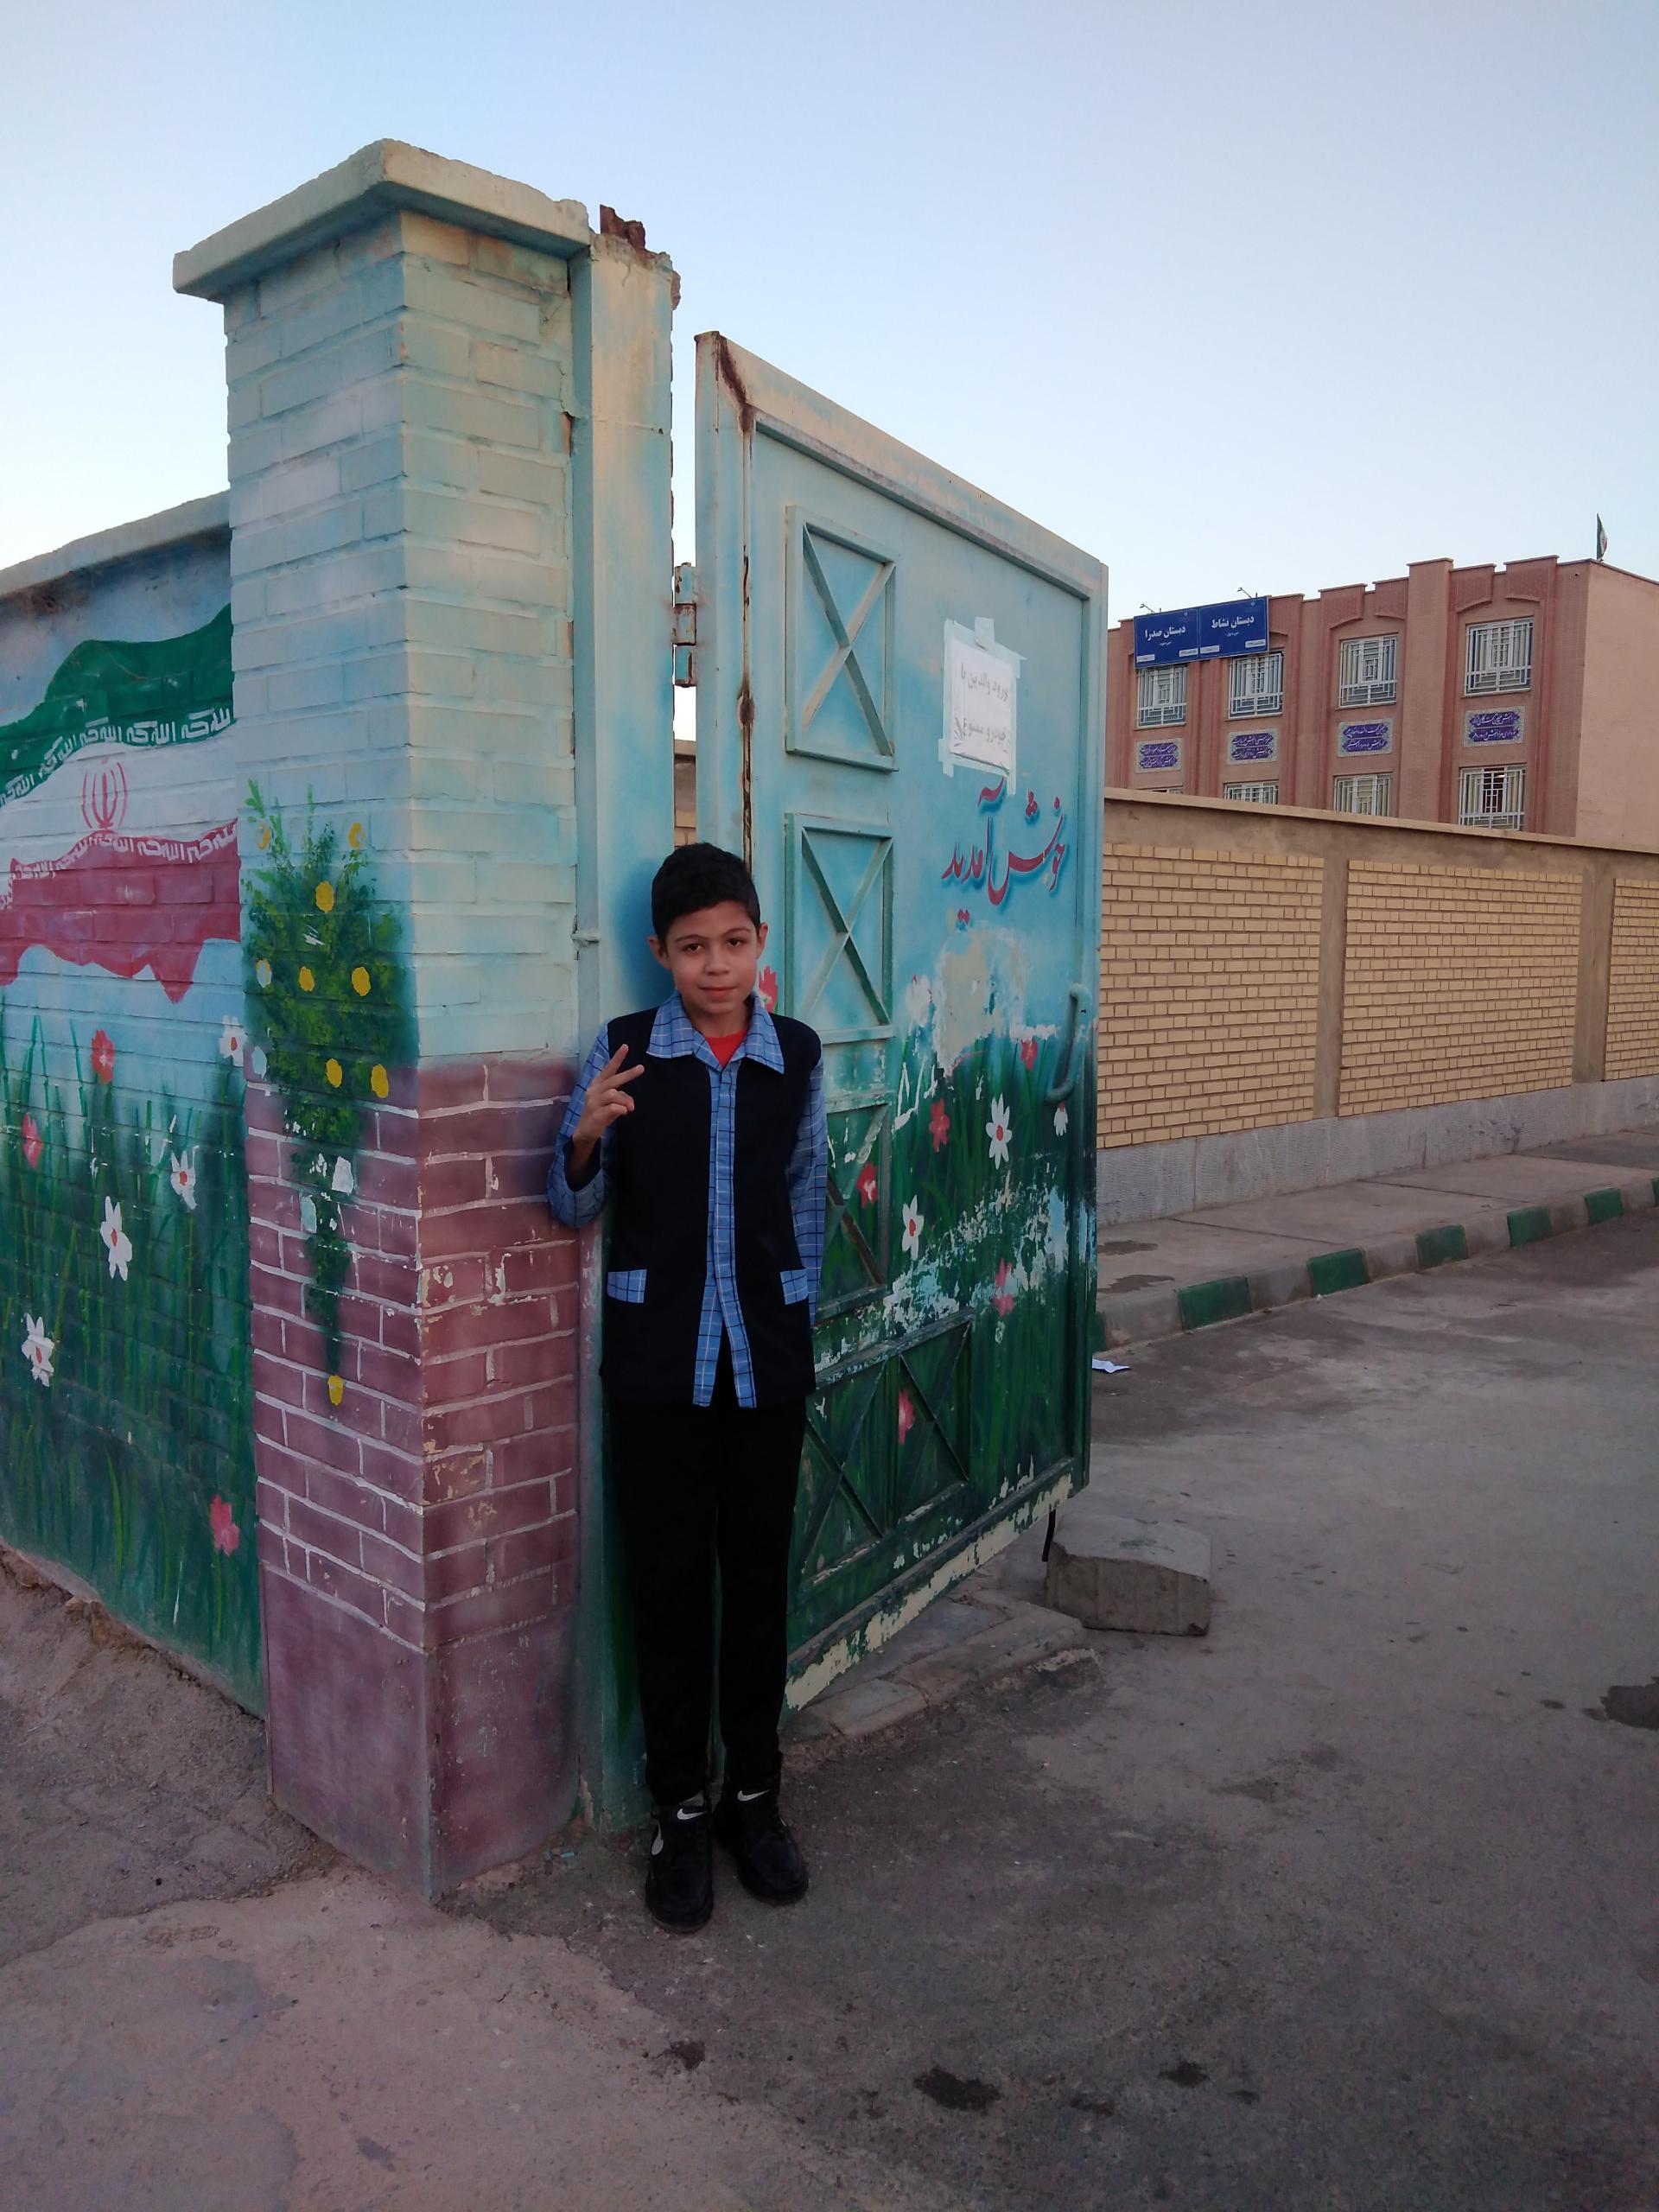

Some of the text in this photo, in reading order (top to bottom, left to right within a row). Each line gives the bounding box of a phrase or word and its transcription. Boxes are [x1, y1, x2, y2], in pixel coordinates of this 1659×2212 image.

[1211, 615, 1255, 629] دبستان نشاط
[1145, 625, 1186, 641] دبستان صدرا
[942, 777, 1065, 925] خوش آمدید
